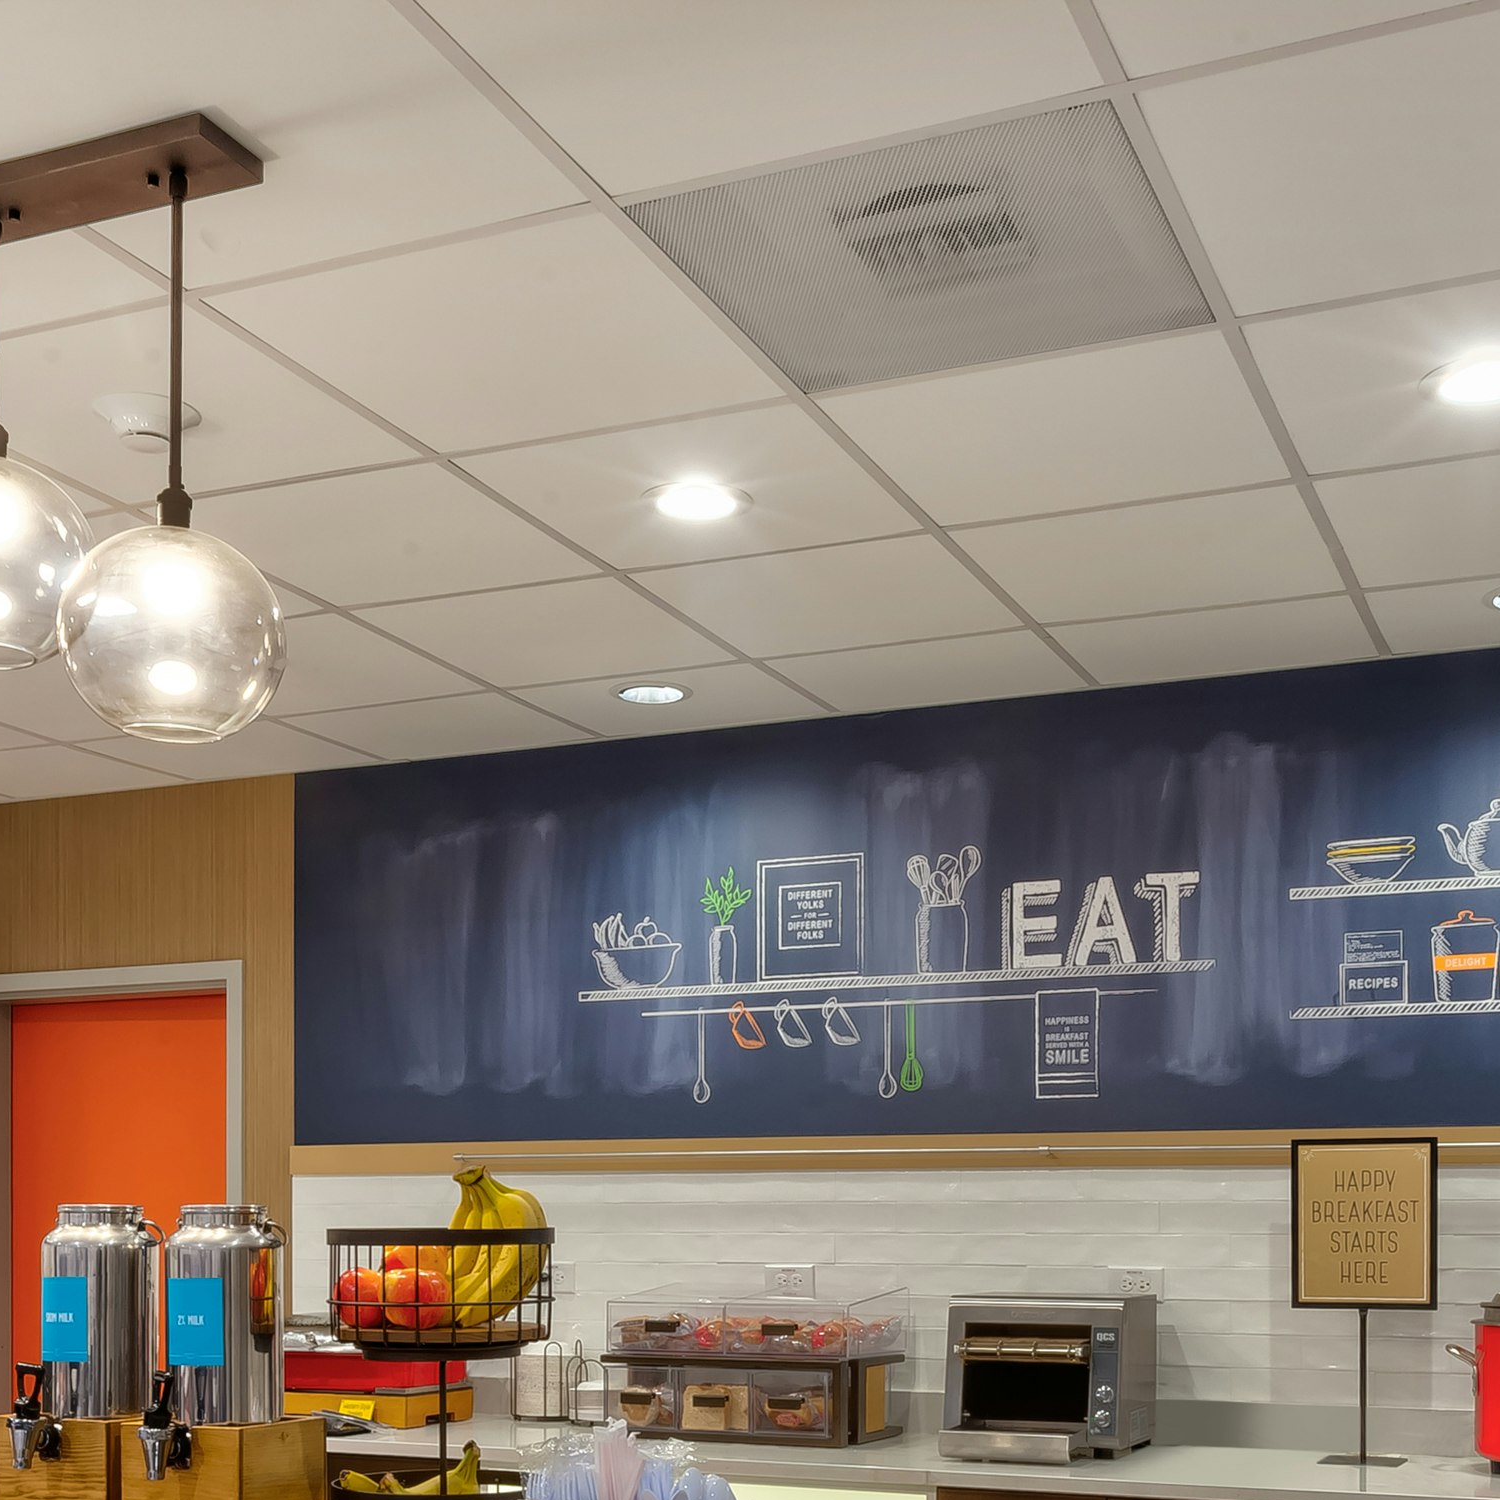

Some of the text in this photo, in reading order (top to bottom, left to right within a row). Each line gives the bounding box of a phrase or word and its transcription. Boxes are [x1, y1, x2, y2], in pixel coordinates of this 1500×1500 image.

[787, 889, 833, 901] DIFFERENT
[796, 900, 824, 910] YOLKS
[787, 919, 833, 931] DIFFERENT
[1002, 870, 1200, 969] EAT
[796, 930, 824, 940] FOLKS
[1444, 956, 1487, 968] DELIGHT
[1348, 976, 1399, 990] RECIPES
[1044, 1015, 1090, 1026] HAPPINESS
[1045, 1032, 1090, 1042] BREAKFAST
[1045, 1041, 1068, 1049] SERVED
[1045, 1048, 1090, 1065] SMILE
[1334, 1169, 1396, 1193] HAPPY
[1311, 1199, 1420, 1224] BREAKFAST
[1329, 1230, 1399, 1254] STARTS
[1340, 1260, 1389, 1284] HERE
[58, 1312, 74, 1323] MILK
[187, 1315, 204, 1326] MILK
[1096, 1332, 1116, 1342] QCS
